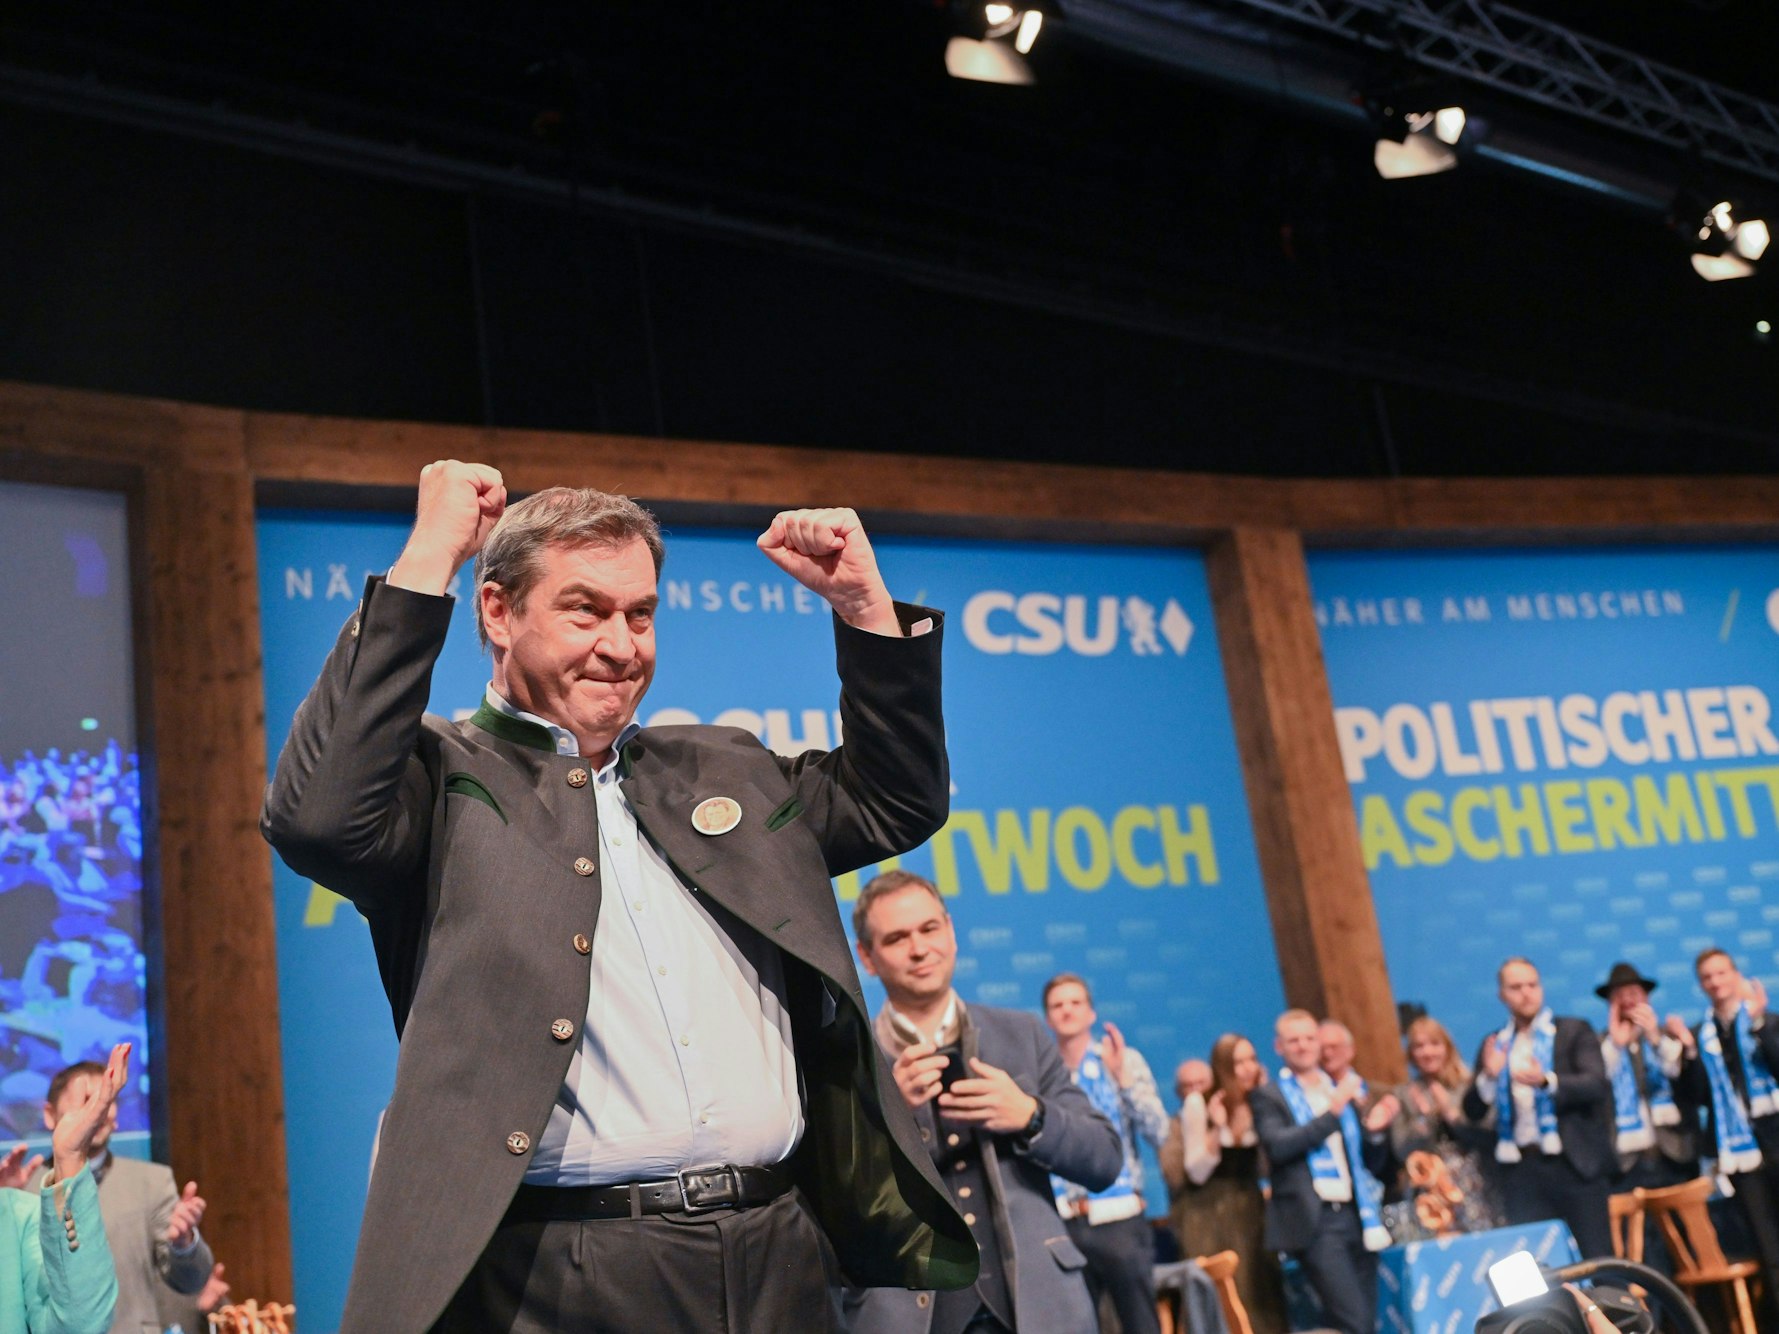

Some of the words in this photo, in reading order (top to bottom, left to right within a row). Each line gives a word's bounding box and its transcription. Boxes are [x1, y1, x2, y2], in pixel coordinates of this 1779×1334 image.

[962, 590, 1119, 656] CSU
[1442, 595, 1491, 622] AM
[1507, 588, 1684, 621] MENSCHEN
[1334, 685, 1779, 782] POLITISCHER
